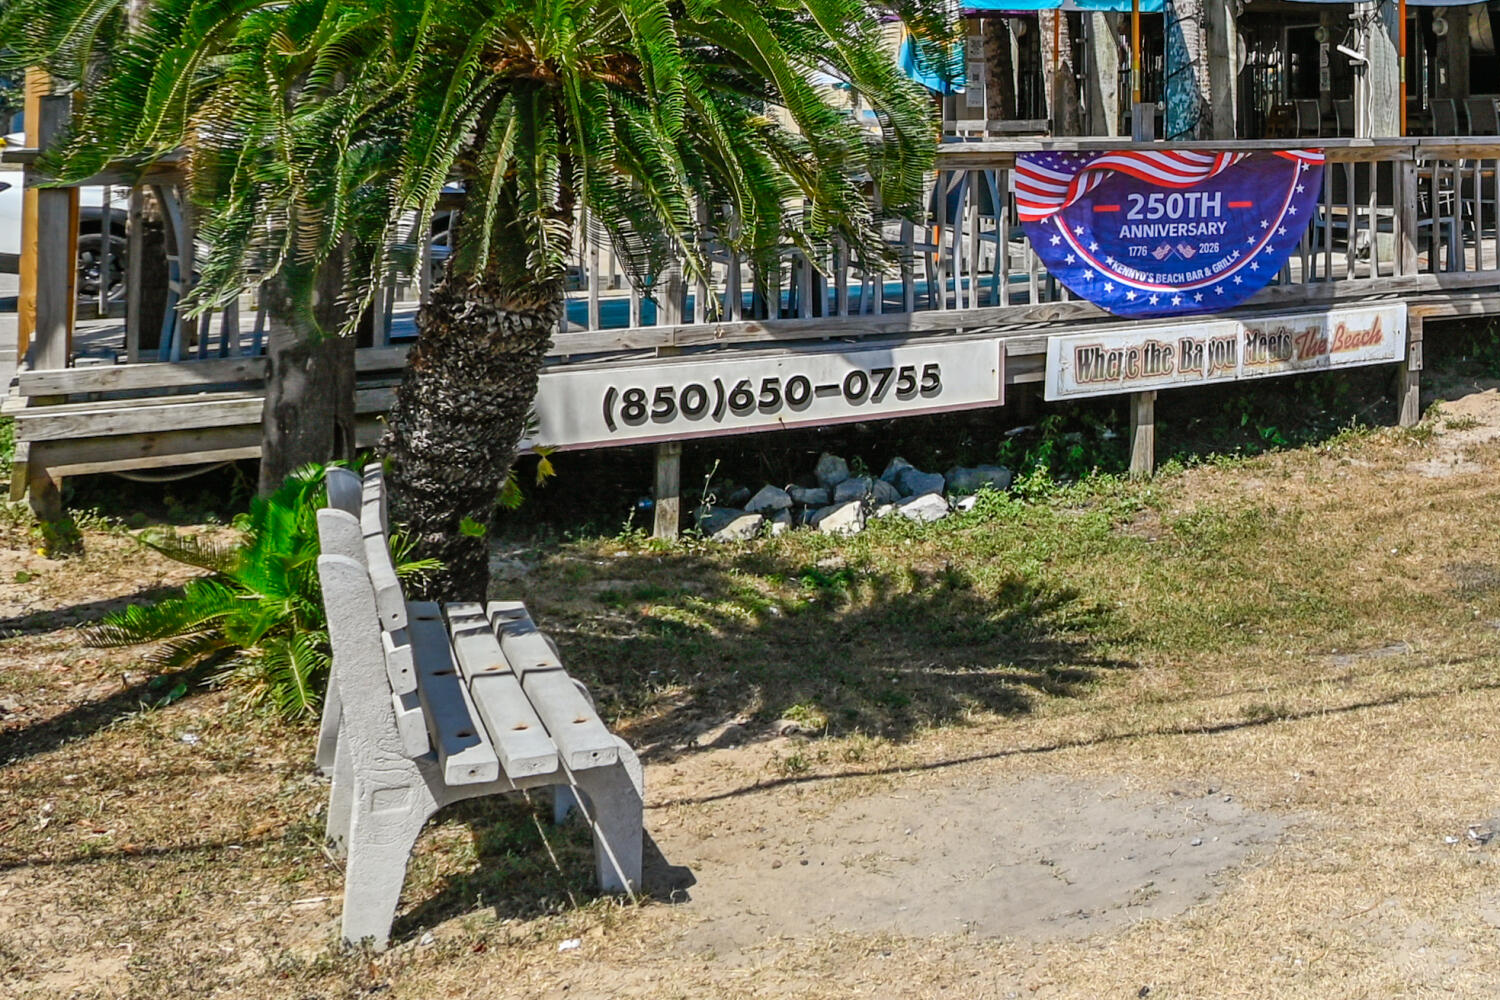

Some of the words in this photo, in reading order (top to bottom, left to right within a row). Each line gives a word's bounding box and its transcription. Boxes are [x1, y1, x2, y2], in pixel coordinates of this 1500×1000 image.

[1126, 191, 1222, 220] 250TH
[1119, 221, 1227, 239] ANNIVERSARY
[1128, 245, 1148, 257] 1776
[1199, 242, 1220, 254] 2026
[1155, 272, 1185, 284] BEACH
[1187, 270, 1204, 283] BAR
[1205, 266, 1212, 277] &
[1212, 254, 1236, 273] GRILL
[1074, 343, 1139, 385] Where
[1141, 338, 1175, 378] the
[1177, 335, 1239, 378] Bayou
[1244, 325, 1293, 366] Meets
[1294, 330, 1330, 362] The
[1330, 314, 1384, 353] Beach
